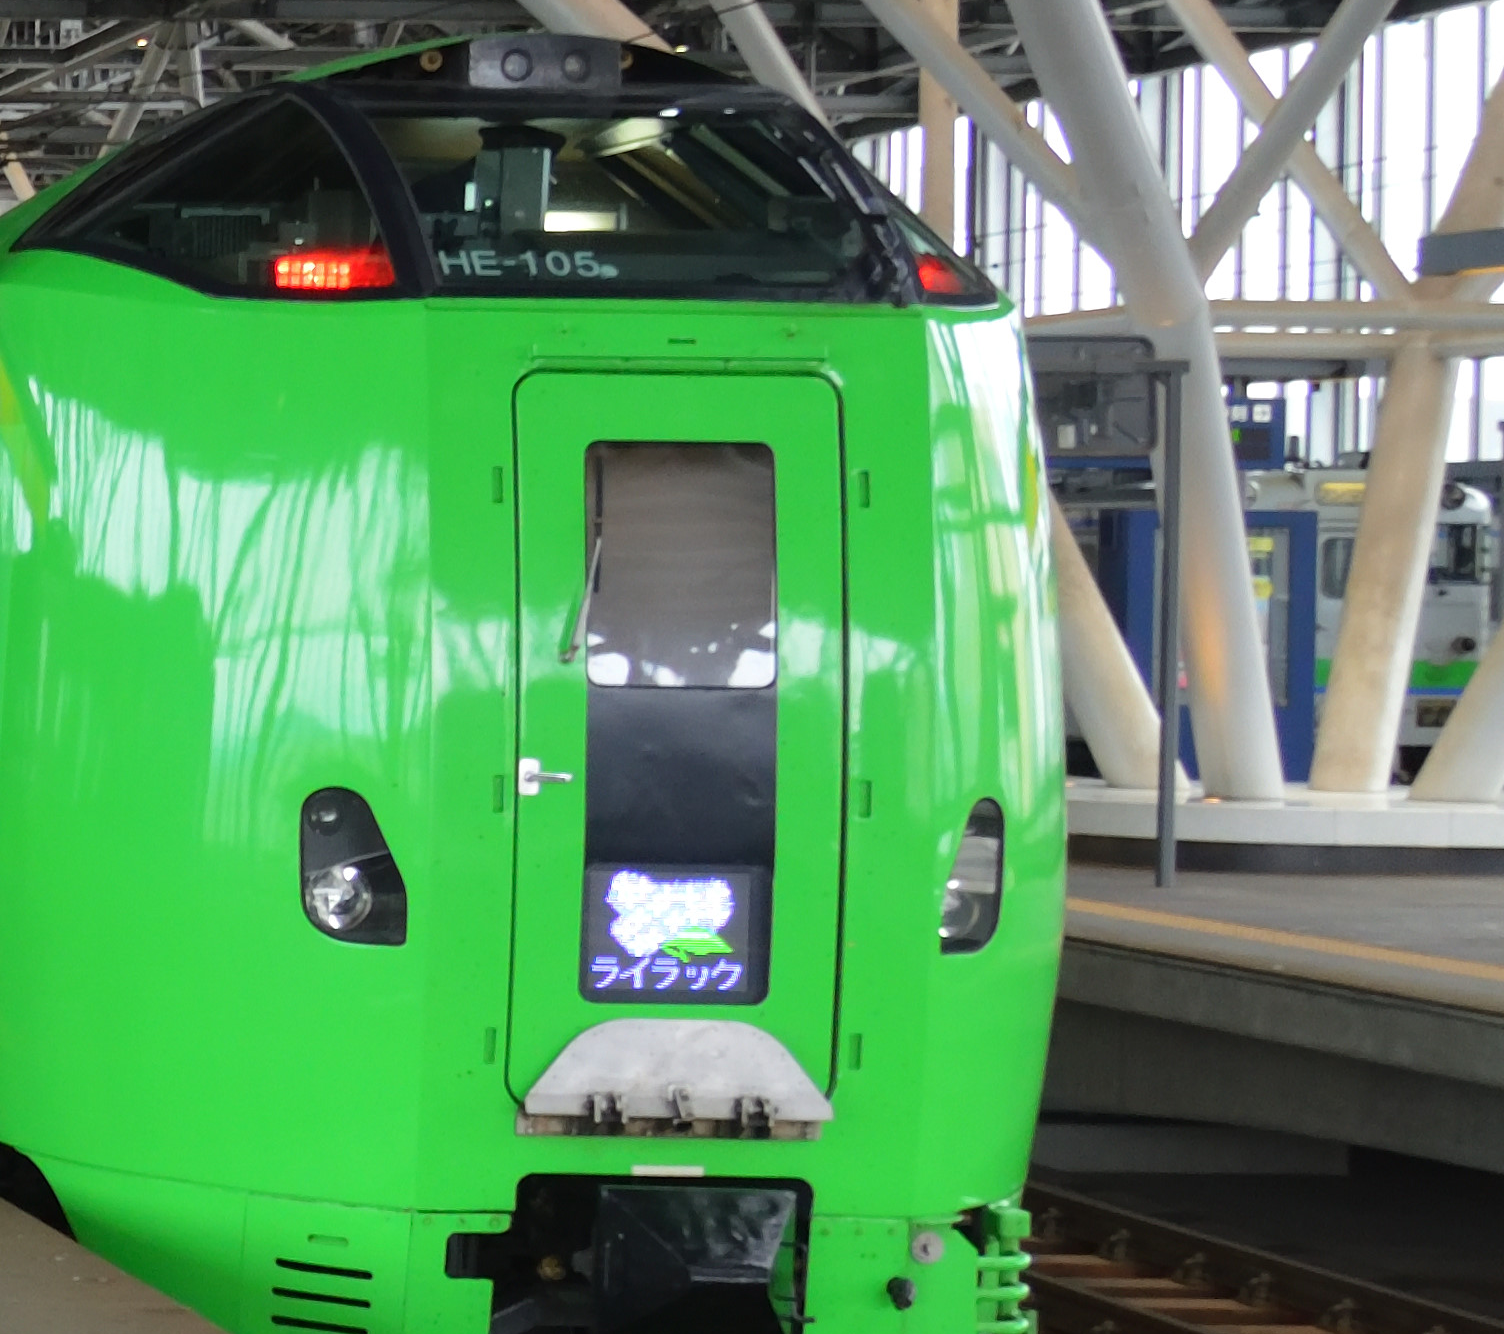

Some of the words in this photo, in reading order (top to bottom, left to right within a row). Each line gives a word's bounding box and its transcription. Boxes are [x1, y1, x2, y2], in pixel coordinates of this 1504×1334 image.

[439, 249, 600, 277] HE-105
[591, 956, 743, 990] ライラック
